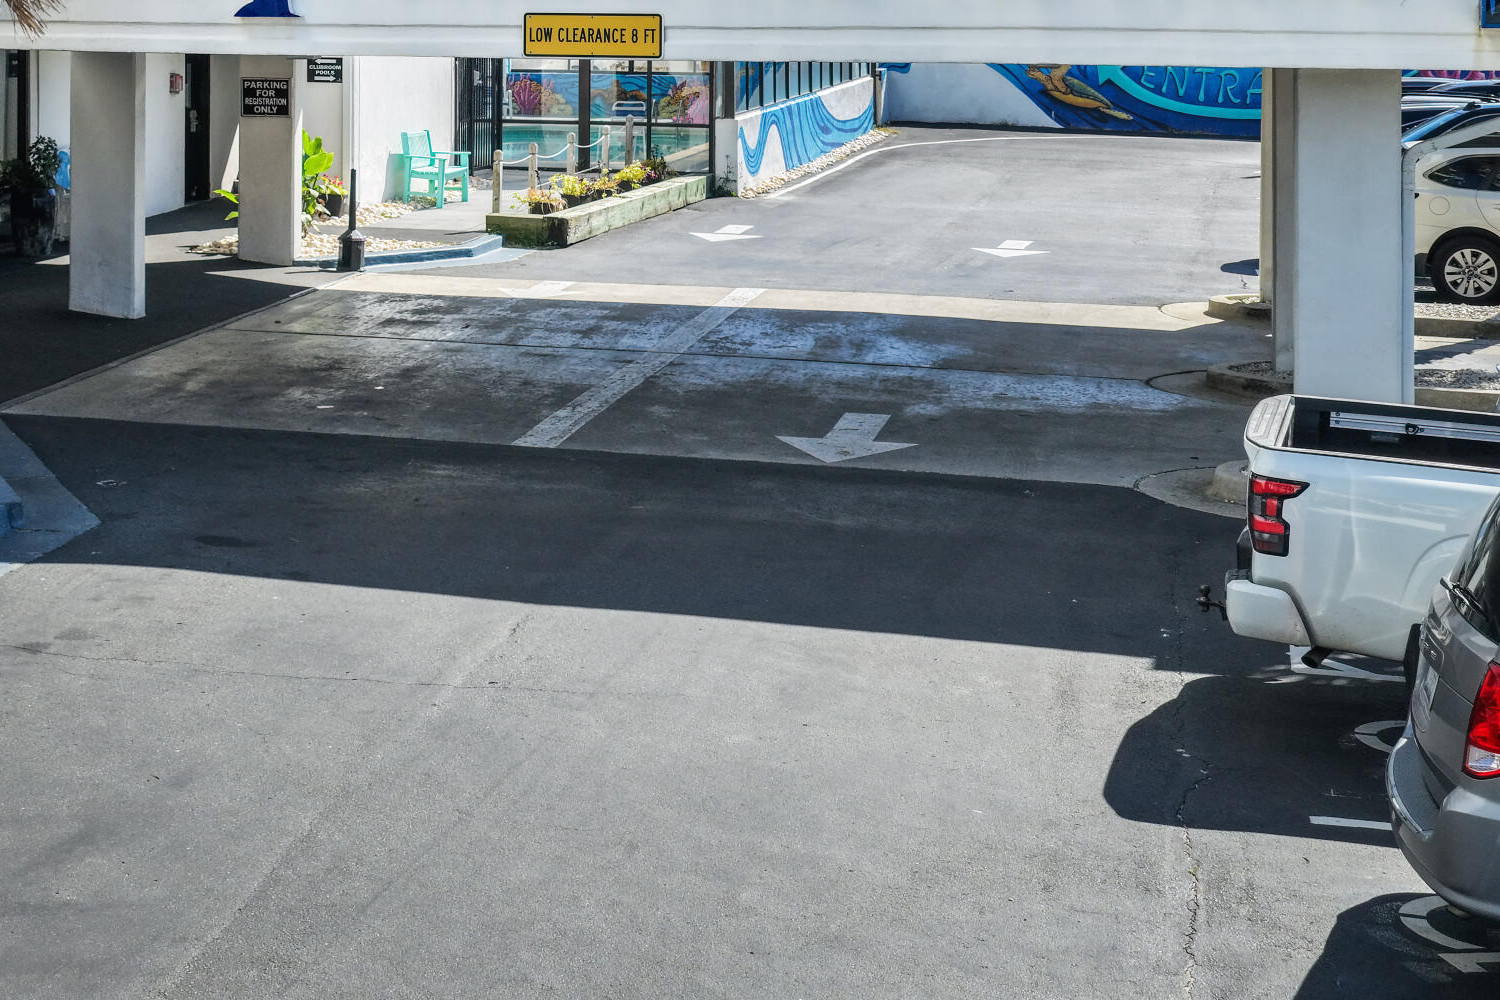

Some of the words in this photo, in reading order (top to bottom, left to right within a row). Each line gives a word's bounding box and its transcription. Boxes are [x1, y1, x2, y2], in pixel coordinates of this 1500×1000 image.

[529, 27, 552, 42] LOW
[558, 28, 626, 43] CLEARANCE
[631, 29, 638, 43] 8
[644, 29, 656, 43] FT
[244, 81, 287, 89] PARKING
[256, 89, 275, 97] FOR
